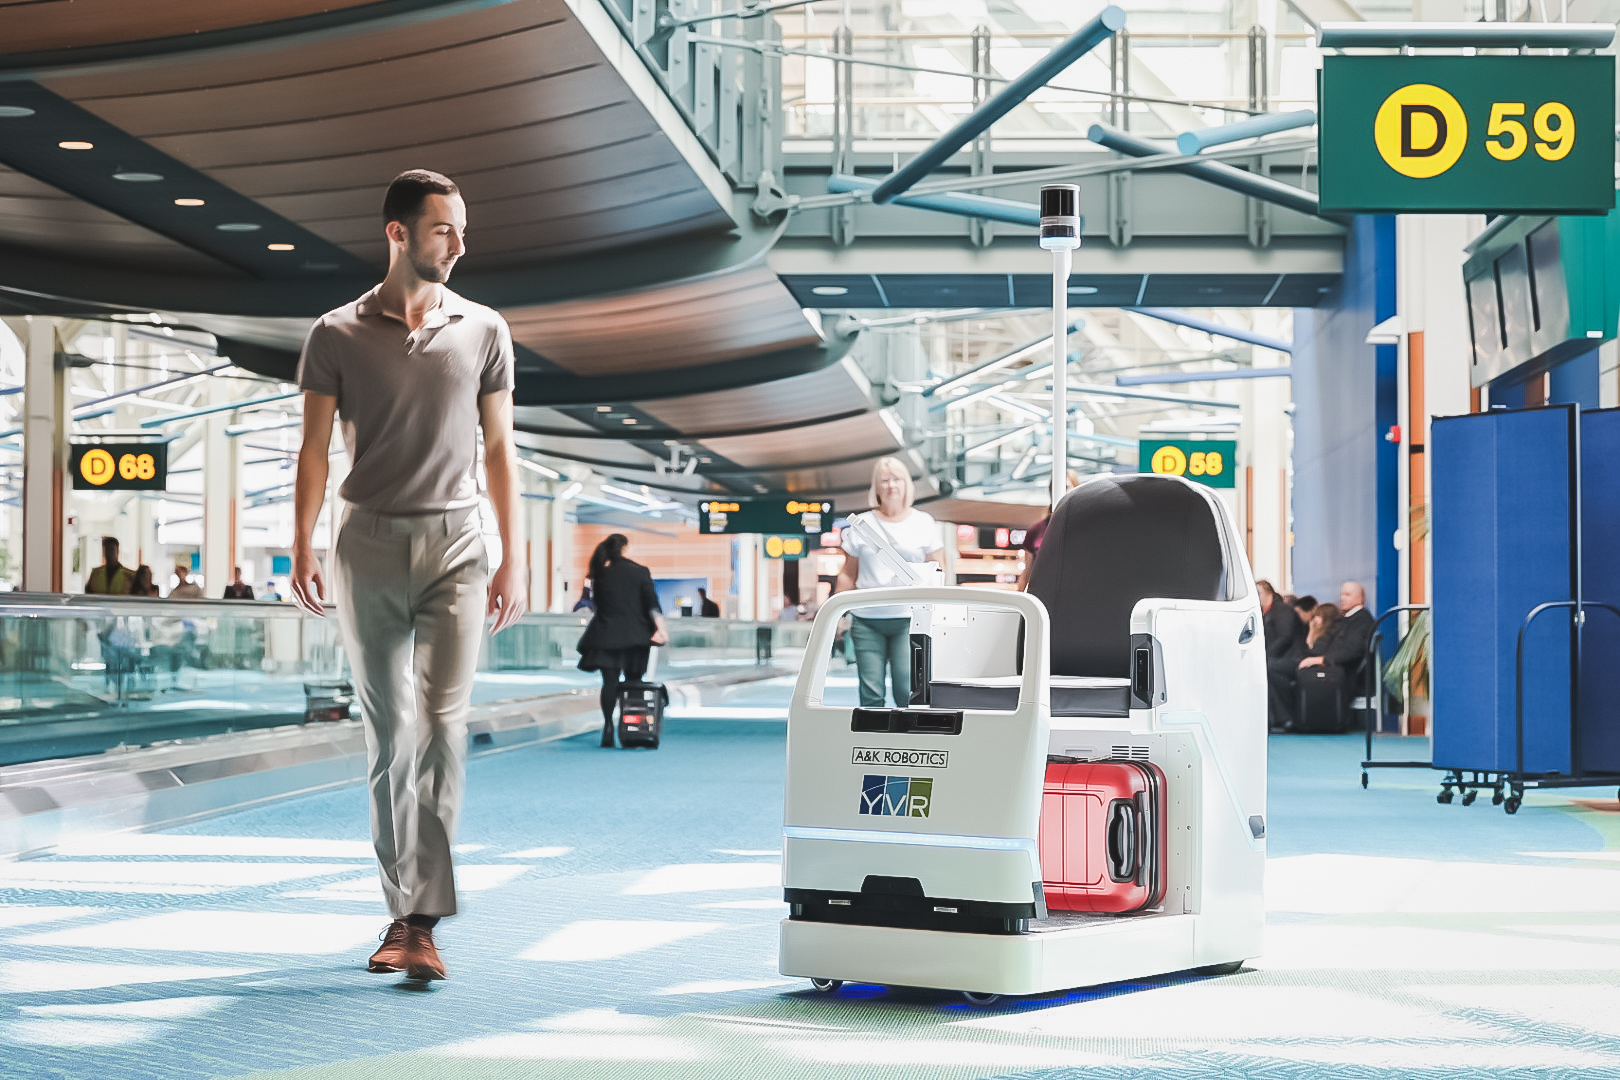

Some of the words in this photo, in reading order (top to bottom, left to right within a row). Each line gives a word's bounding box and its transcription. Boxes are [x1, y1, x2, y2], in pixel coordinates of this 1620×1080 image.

[1400, 104, 1448, 158] D
[1485, 101, 1576, 161] 59
[91, 457, 106, 476] D
[119, 453, 156, 480] 68
[1162, 455, 1177, 473] D
[1189, 451, 1223, 476] 58
[855, 750, 881, 763] A&K
[884, 751, 946, 765] ROBOTICS
[861, 791, 929, 818] YVR
